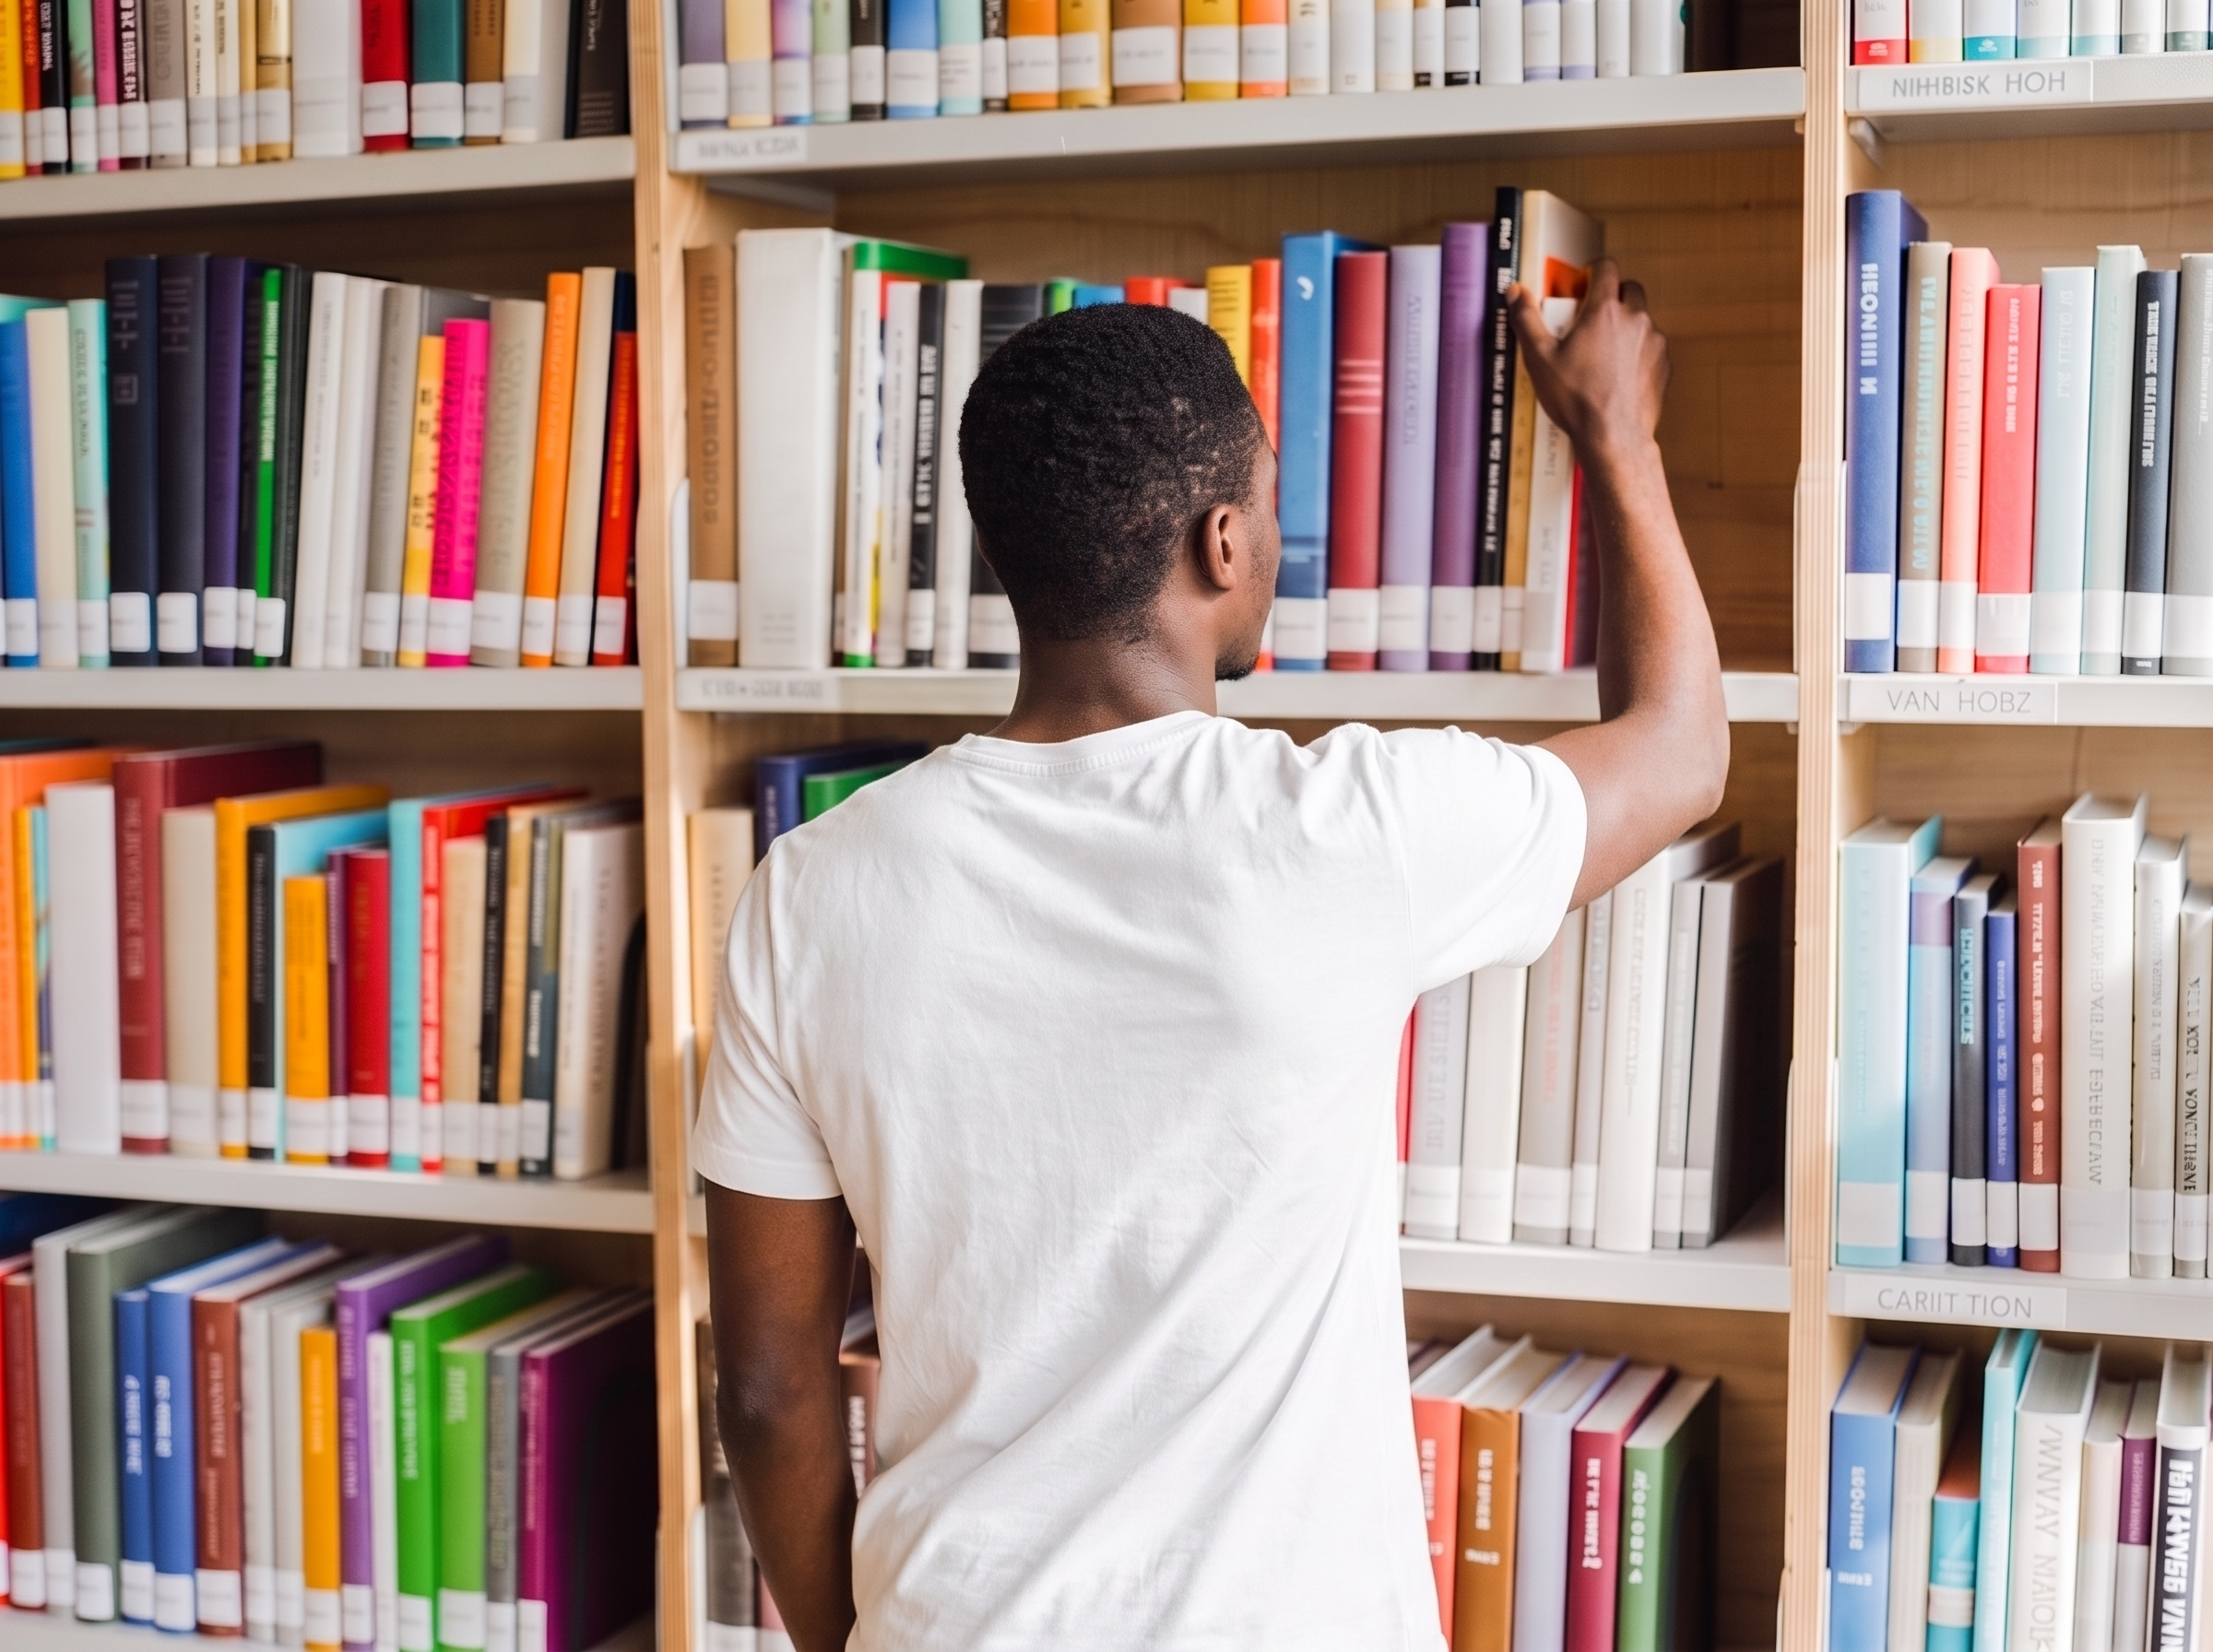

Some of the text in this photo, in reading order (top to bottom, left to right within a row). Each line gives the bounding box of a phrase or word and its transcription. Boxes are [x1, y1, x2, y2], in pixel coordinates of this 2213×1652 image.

[2005, 70, 2066, 93] HOH
[1887, 690, 2031, 714] VAN HOBZ
[1966, 1293, 2032, 1318] TION
